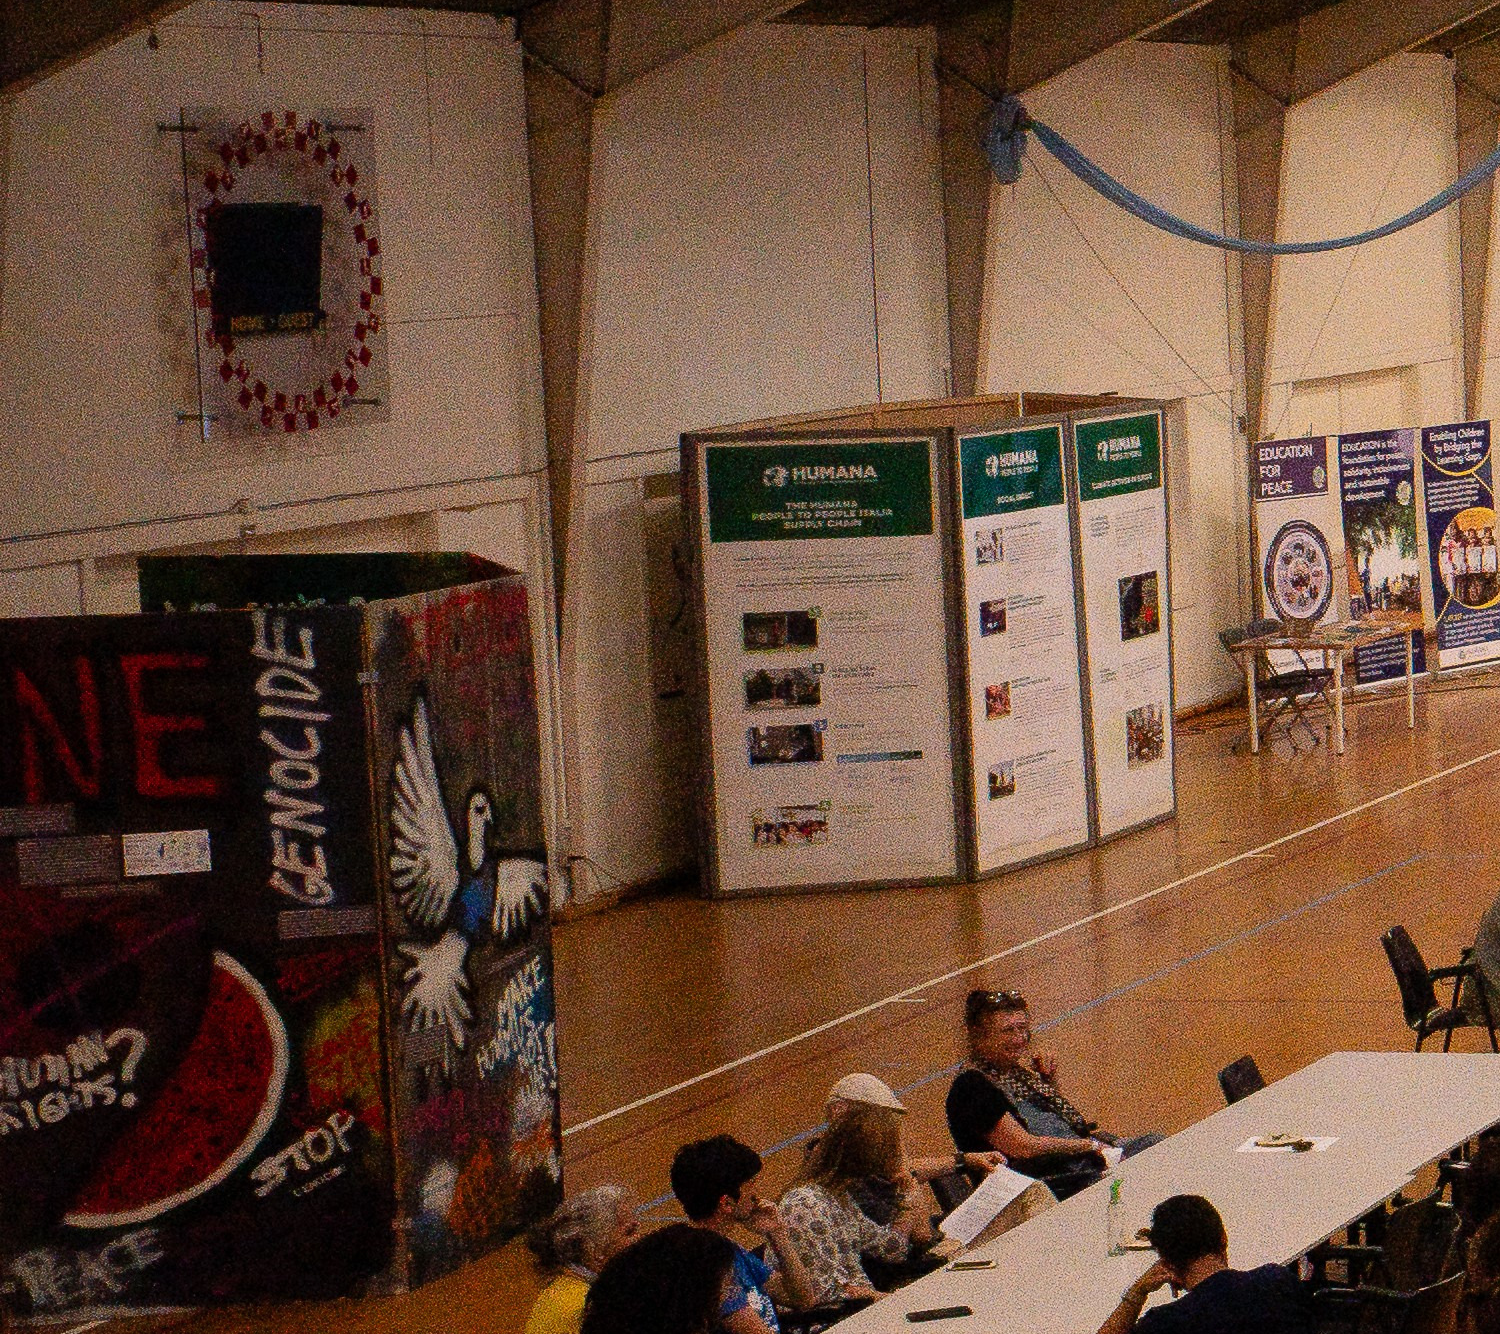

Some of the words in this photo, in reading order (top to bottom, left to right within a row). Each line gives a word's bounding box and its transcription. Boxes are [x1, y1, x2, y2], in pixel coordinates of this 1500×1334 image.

[1259, 444, 1313, 462] EDUCATION
[1342, 440, 1381, 453] EDUCATION
[791, 464, 878, 482] HUMANA
[1260, 465, 1281, 478] FOR
[1261, 480, 1294, 496] PEACE
[797, 511, 812, 520] TO
[251, 609, 335, 906] GENOCIDE
[249, 1110, 357, 1199] STOP
